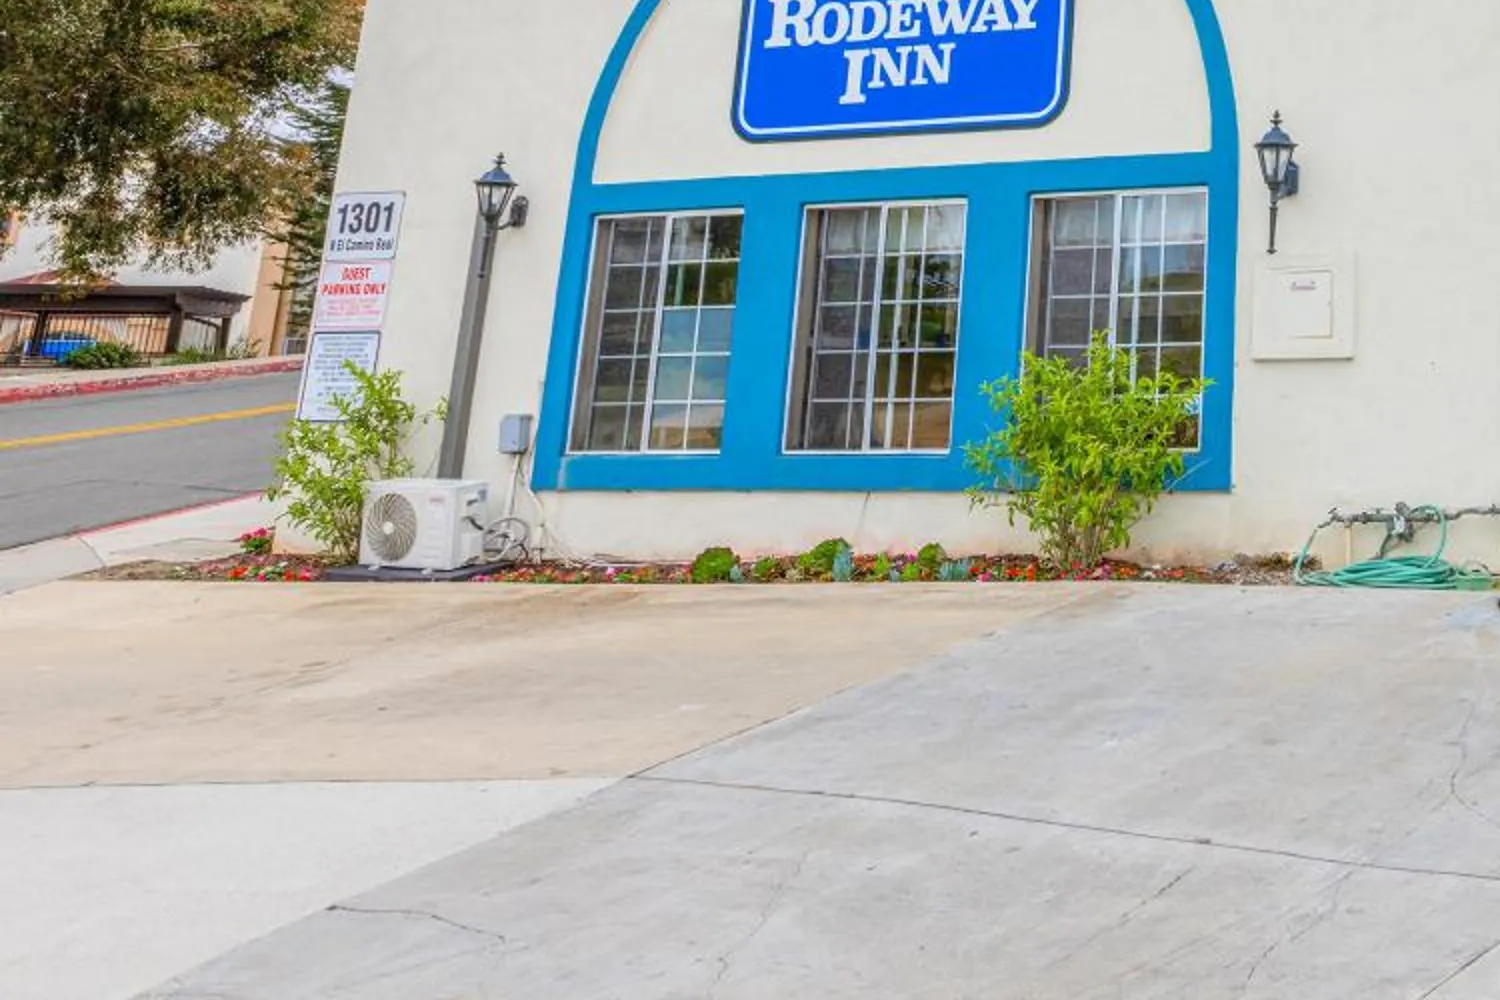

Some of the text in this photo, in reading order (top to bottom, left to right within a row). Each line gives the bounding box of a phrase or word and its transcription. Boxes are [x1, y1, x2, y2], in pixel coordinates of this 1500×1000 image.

[839, 43, 957, 105] INN
[338, 201, 395, 234] 1301
[341, 267, 372, 281] GUEST
[321, 283, 386, 296] PARKING ONLY
